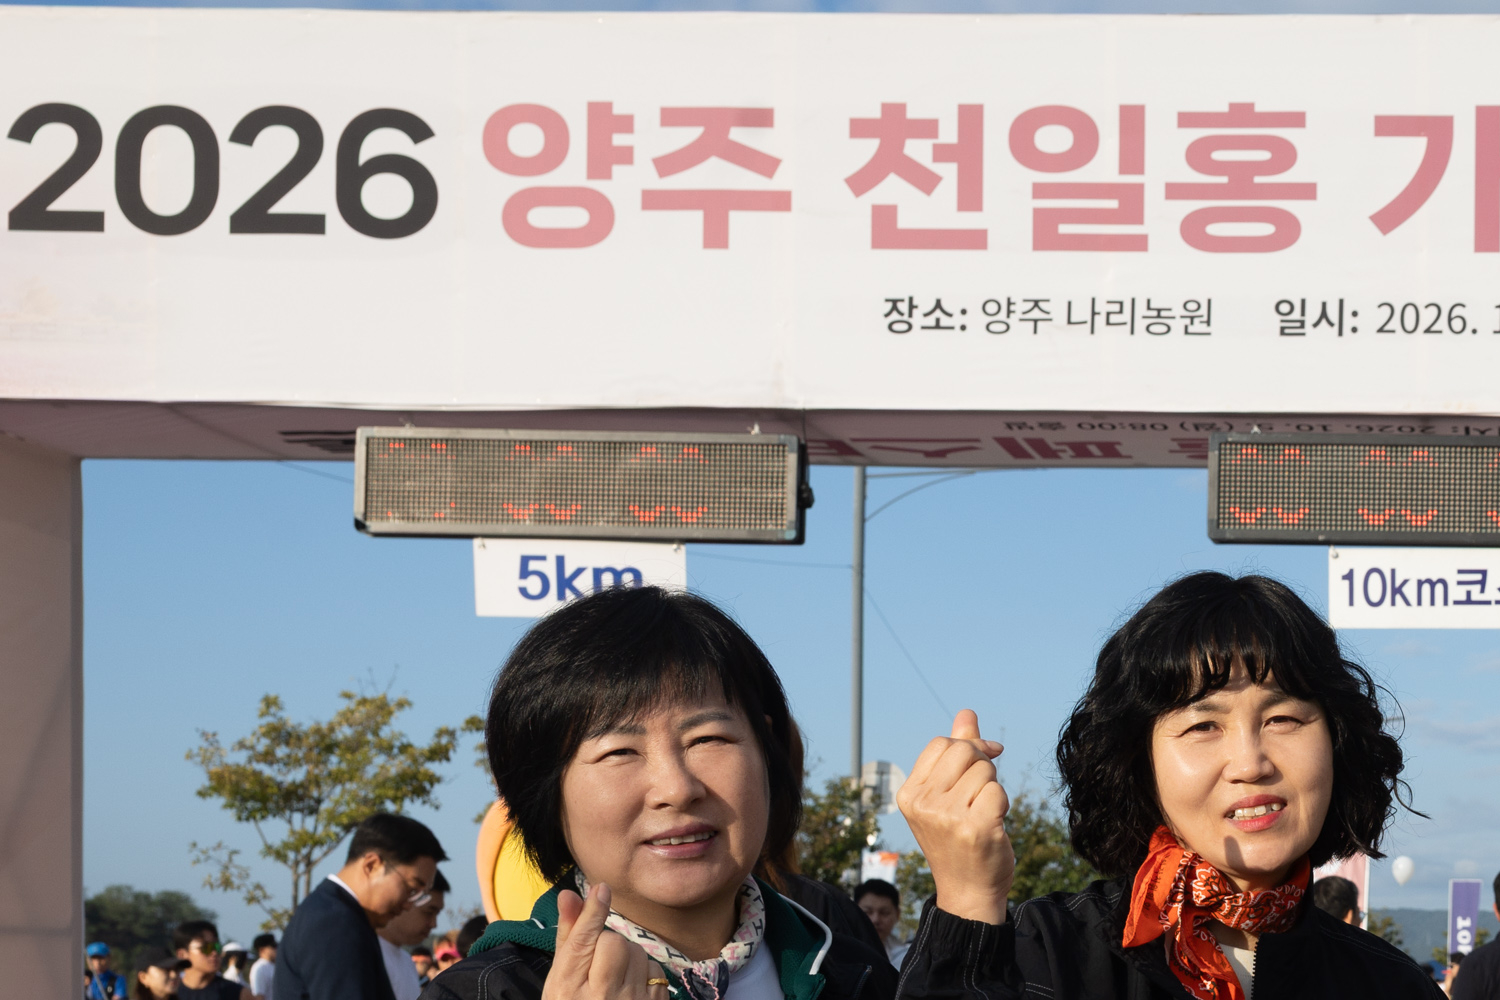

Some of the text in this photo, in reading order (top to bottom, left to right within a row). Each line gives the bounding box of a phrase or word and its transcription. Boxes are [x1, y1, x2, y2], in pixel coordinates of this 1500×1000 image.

[8, 103, 438, 239] 2026
[483, 102, 791, 249] 양주
[845, 103, 1317, 253] 천일홍
[884, 296, 967, 334] 장소:
[982, 297, 1052, 334] 양주
[1067, 297, 1211, 335] 나리농원
[1275, 299, 1358, 337] 일시:
[1377, 303, 1477, 334] 2026.
